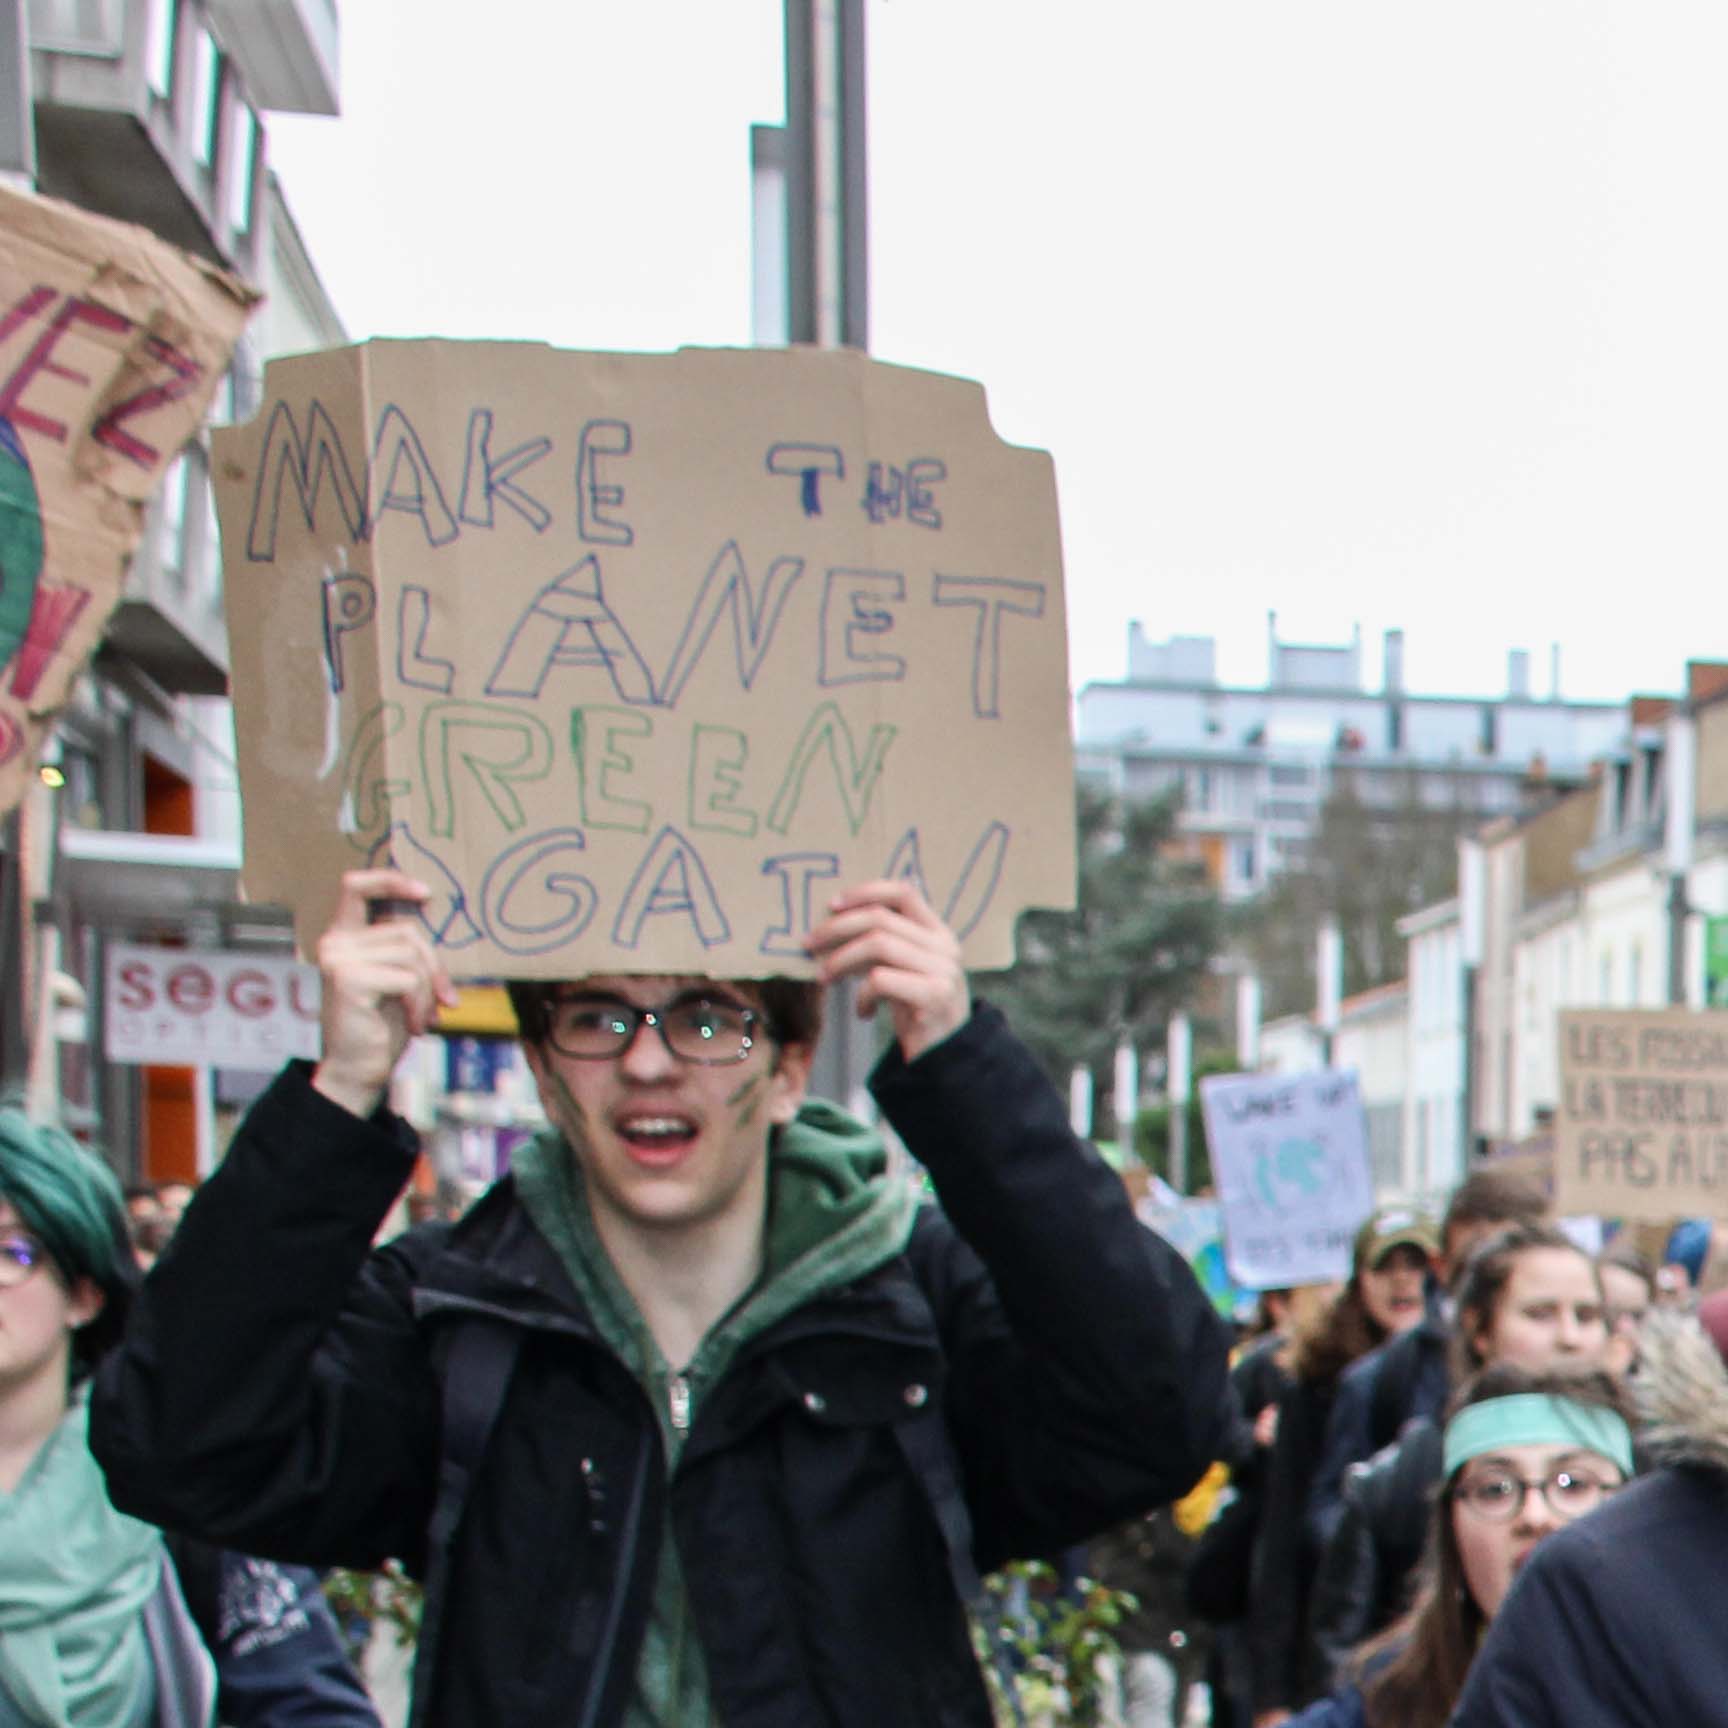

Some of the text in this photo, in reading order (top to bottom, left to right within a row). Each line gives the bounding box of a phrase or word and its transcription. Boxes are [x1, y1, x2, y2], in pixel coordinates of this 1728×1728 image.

[247, 398, 948, 563] MAKE THE
[320, 533, 1047, 724] PLANET
[343, 698, 898, 852] GREEN
